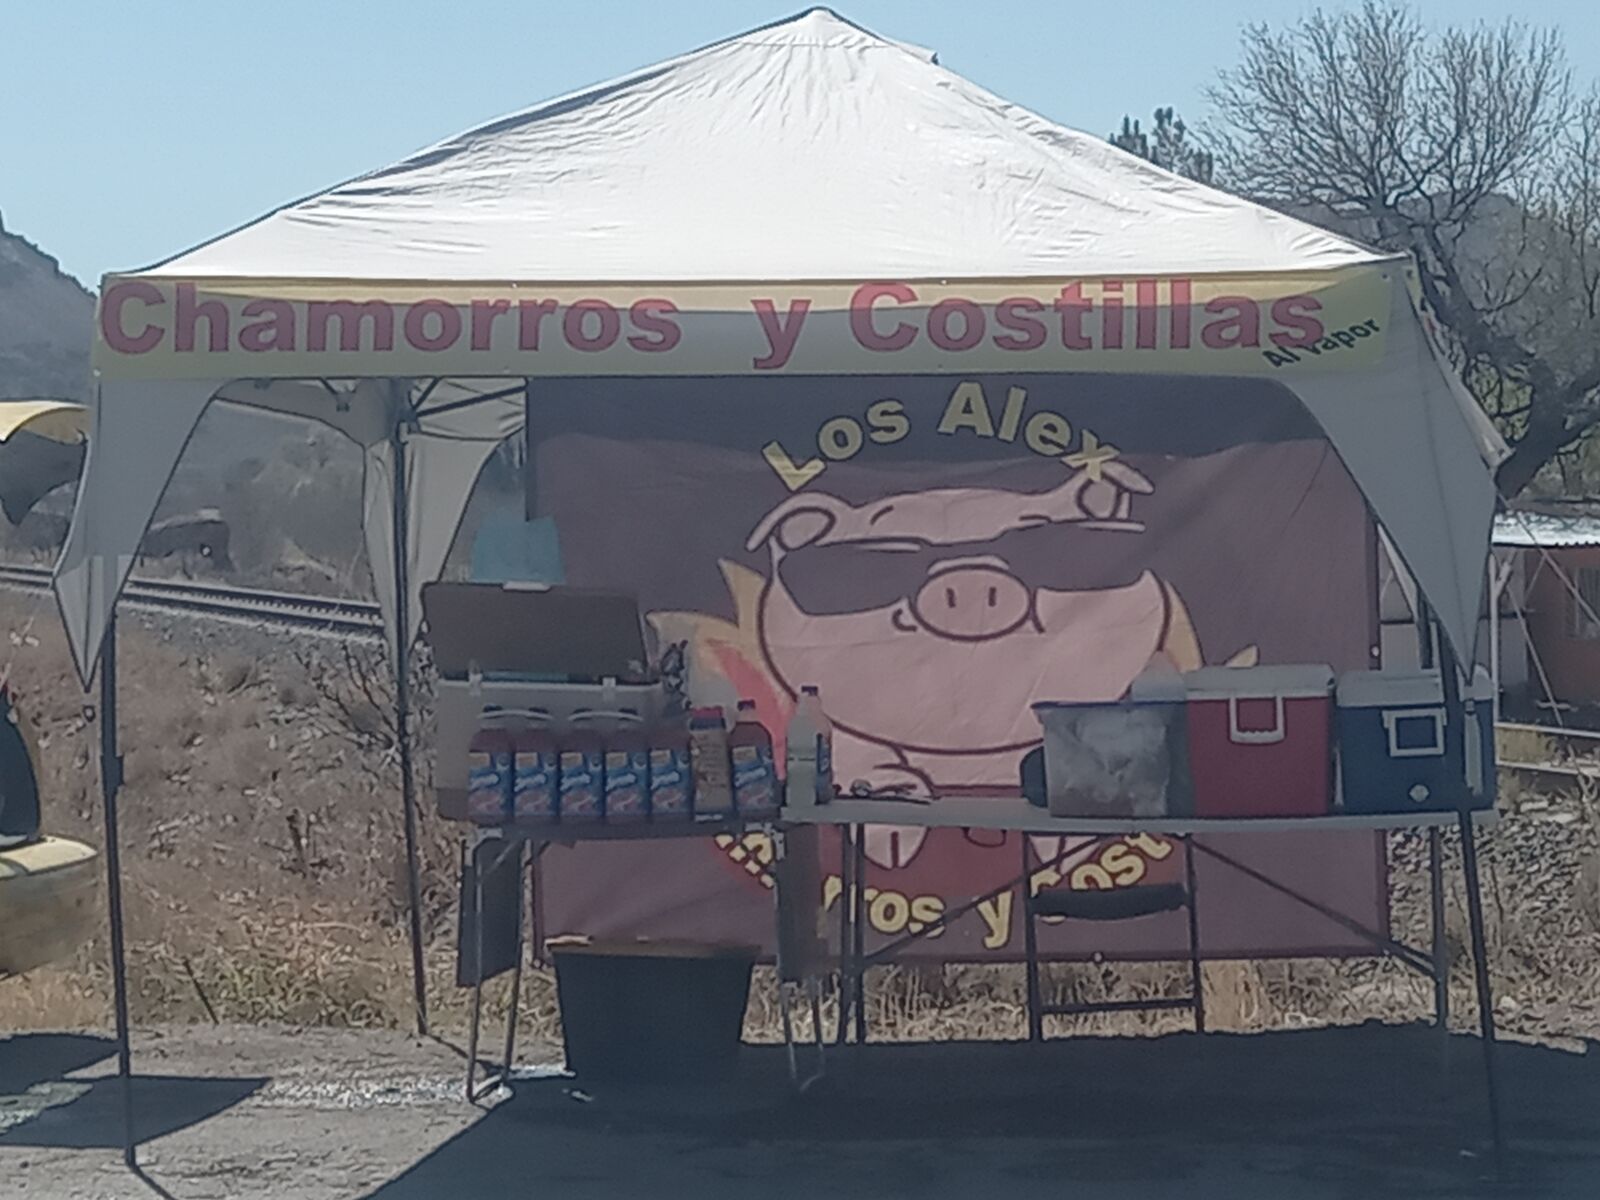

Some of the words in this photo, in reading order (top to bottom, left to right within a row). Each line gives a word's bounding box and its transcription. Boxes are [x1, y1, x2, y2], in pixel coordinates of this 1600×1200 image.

[101, 281, 682, 355] Chamorros
[750, 298, 812, 369] y
[849, 277, 1325, 352] Costillas
[1262, 345, 1301, 368] Al
[760, 399, 911, 493] Los
[936, 380, 1122, 482] Alex
